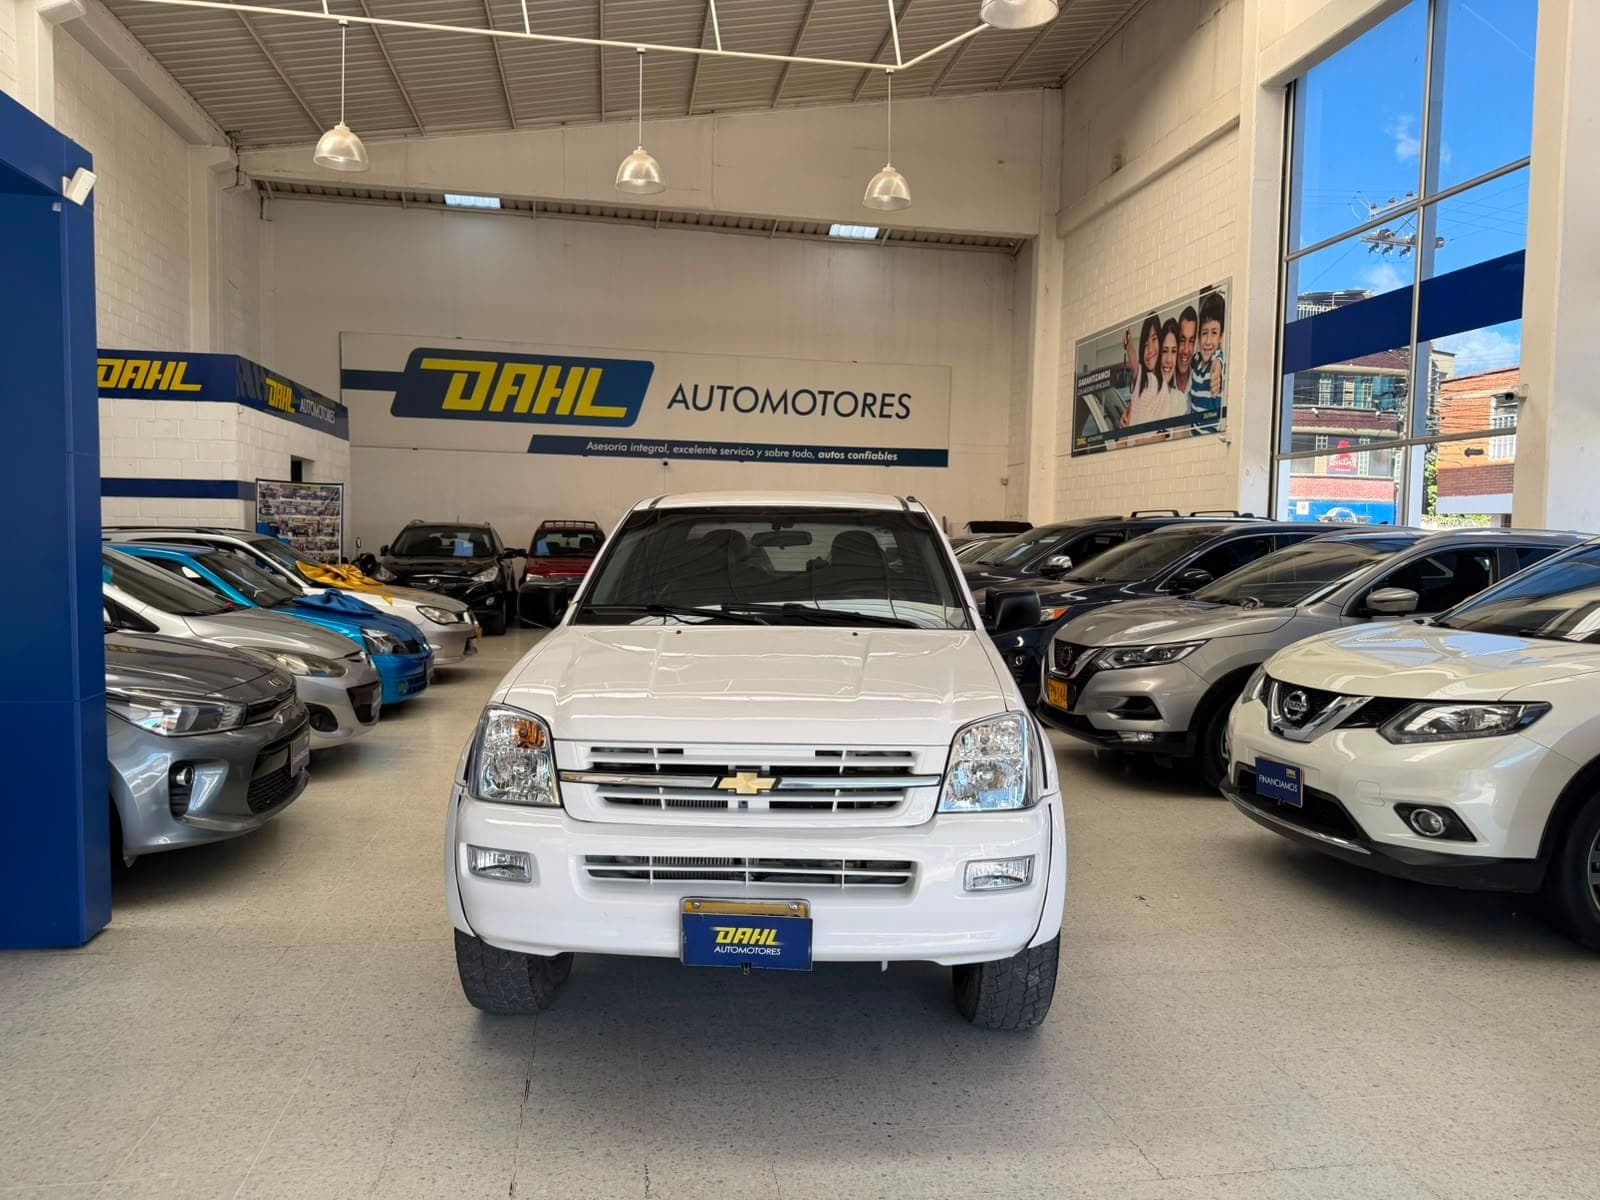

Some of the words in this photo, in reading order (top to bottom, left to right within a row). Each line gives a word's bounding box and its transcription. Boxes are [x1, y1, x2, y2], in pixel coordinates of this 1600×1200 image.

[97, 358, 202, 391] DAHL
[421, 358, 627, 418] DAHL
[667, 383, 912, 420] AUTOMOTORES
[266, 378, 296, 415] DAHL
[300, 398, 335, 424] AUTOMOTORES
[586, 441, 627, 452] Asesoría
[630, 442, 670, 455] integral,
[673, 444, 718, 455] excelente
[719, 447, 754, 457] servicio
[756, 449, 762, 459] y
[764, 448, 790, 458] sobre
[792, 449, 815, 460] todo,
[818, 451, 845, 460] autos
[847, 450, 898, 461] confiables
[1259, 774, 1298, 793] FINANCIAMOS
[711, 927, 783, 946] DAHL
[713, 945, 781, 956] AUTOMOTORES
